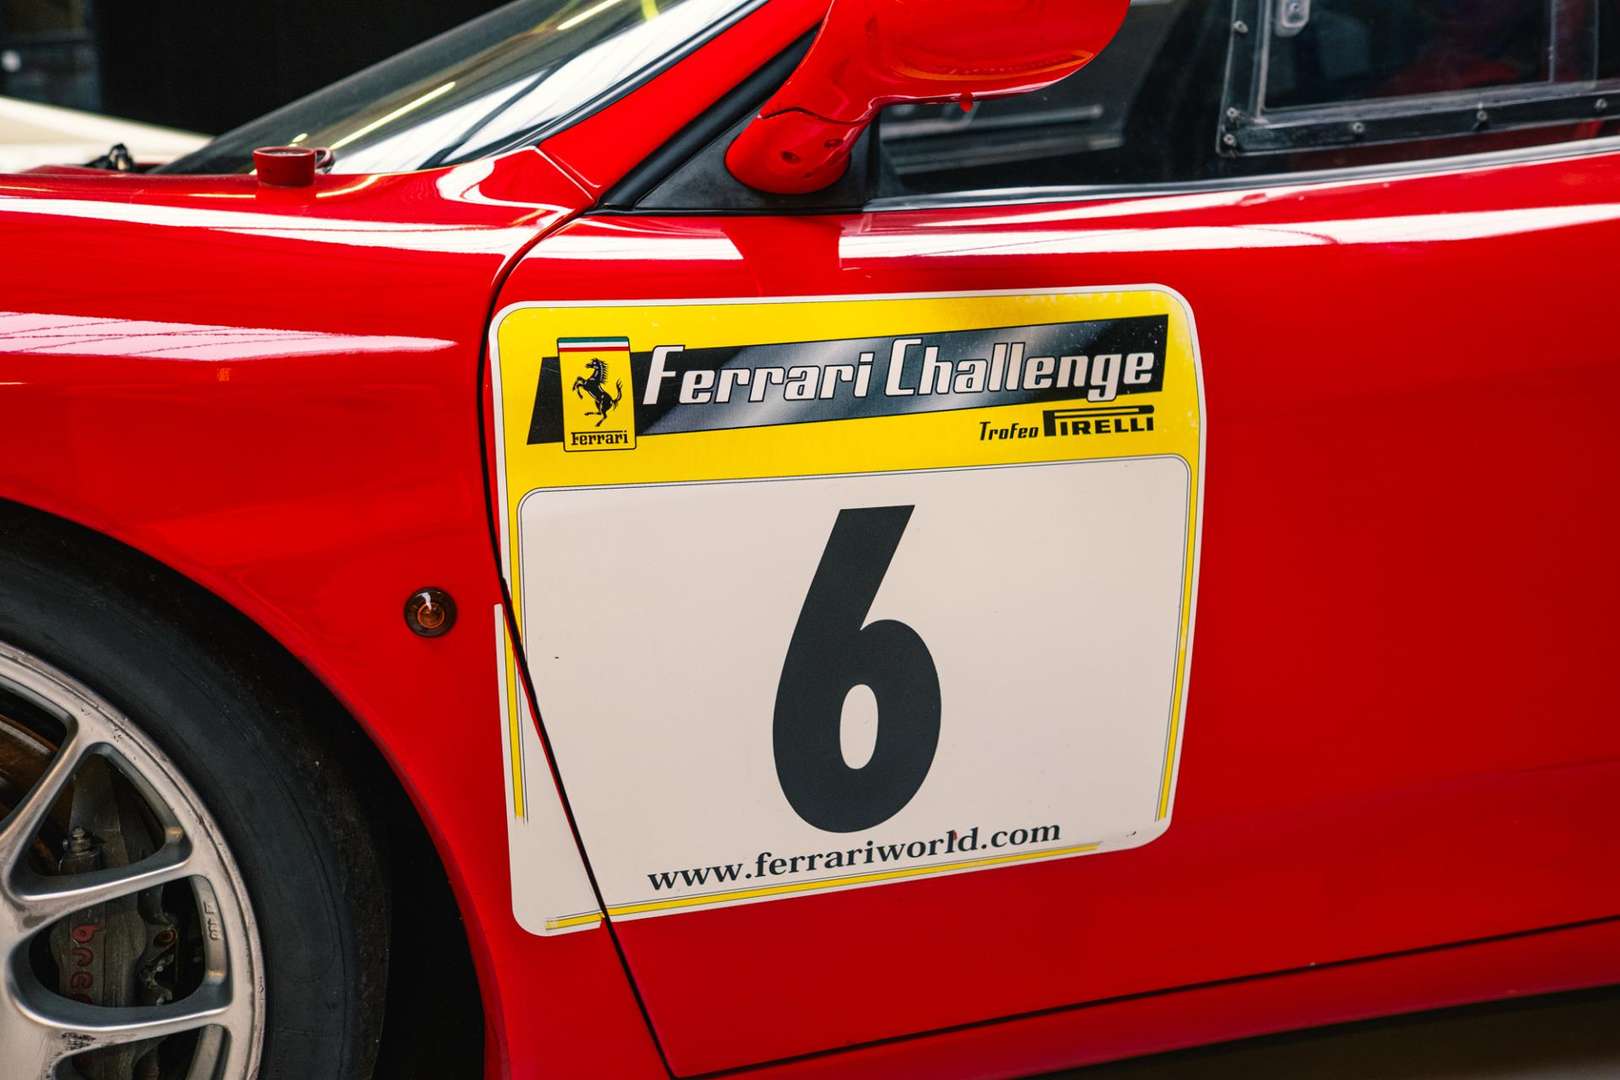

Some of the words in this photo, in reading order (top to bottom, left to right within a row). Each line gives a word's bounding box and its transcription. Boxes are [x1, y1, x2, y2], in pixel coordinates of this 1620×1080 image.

[642, 344, 873, 406] Ferrari
[883, 337, 1155, 403] Challenge
[570, 430, 629, 446] Ferrari
[979, 421, 1039, 441] Trofeo
[1042, 404, 1155, 437] PIRELLI
[772, 504, 942, 833] 6
[647, 824, 1061, 892] www.ferrariworld.com
